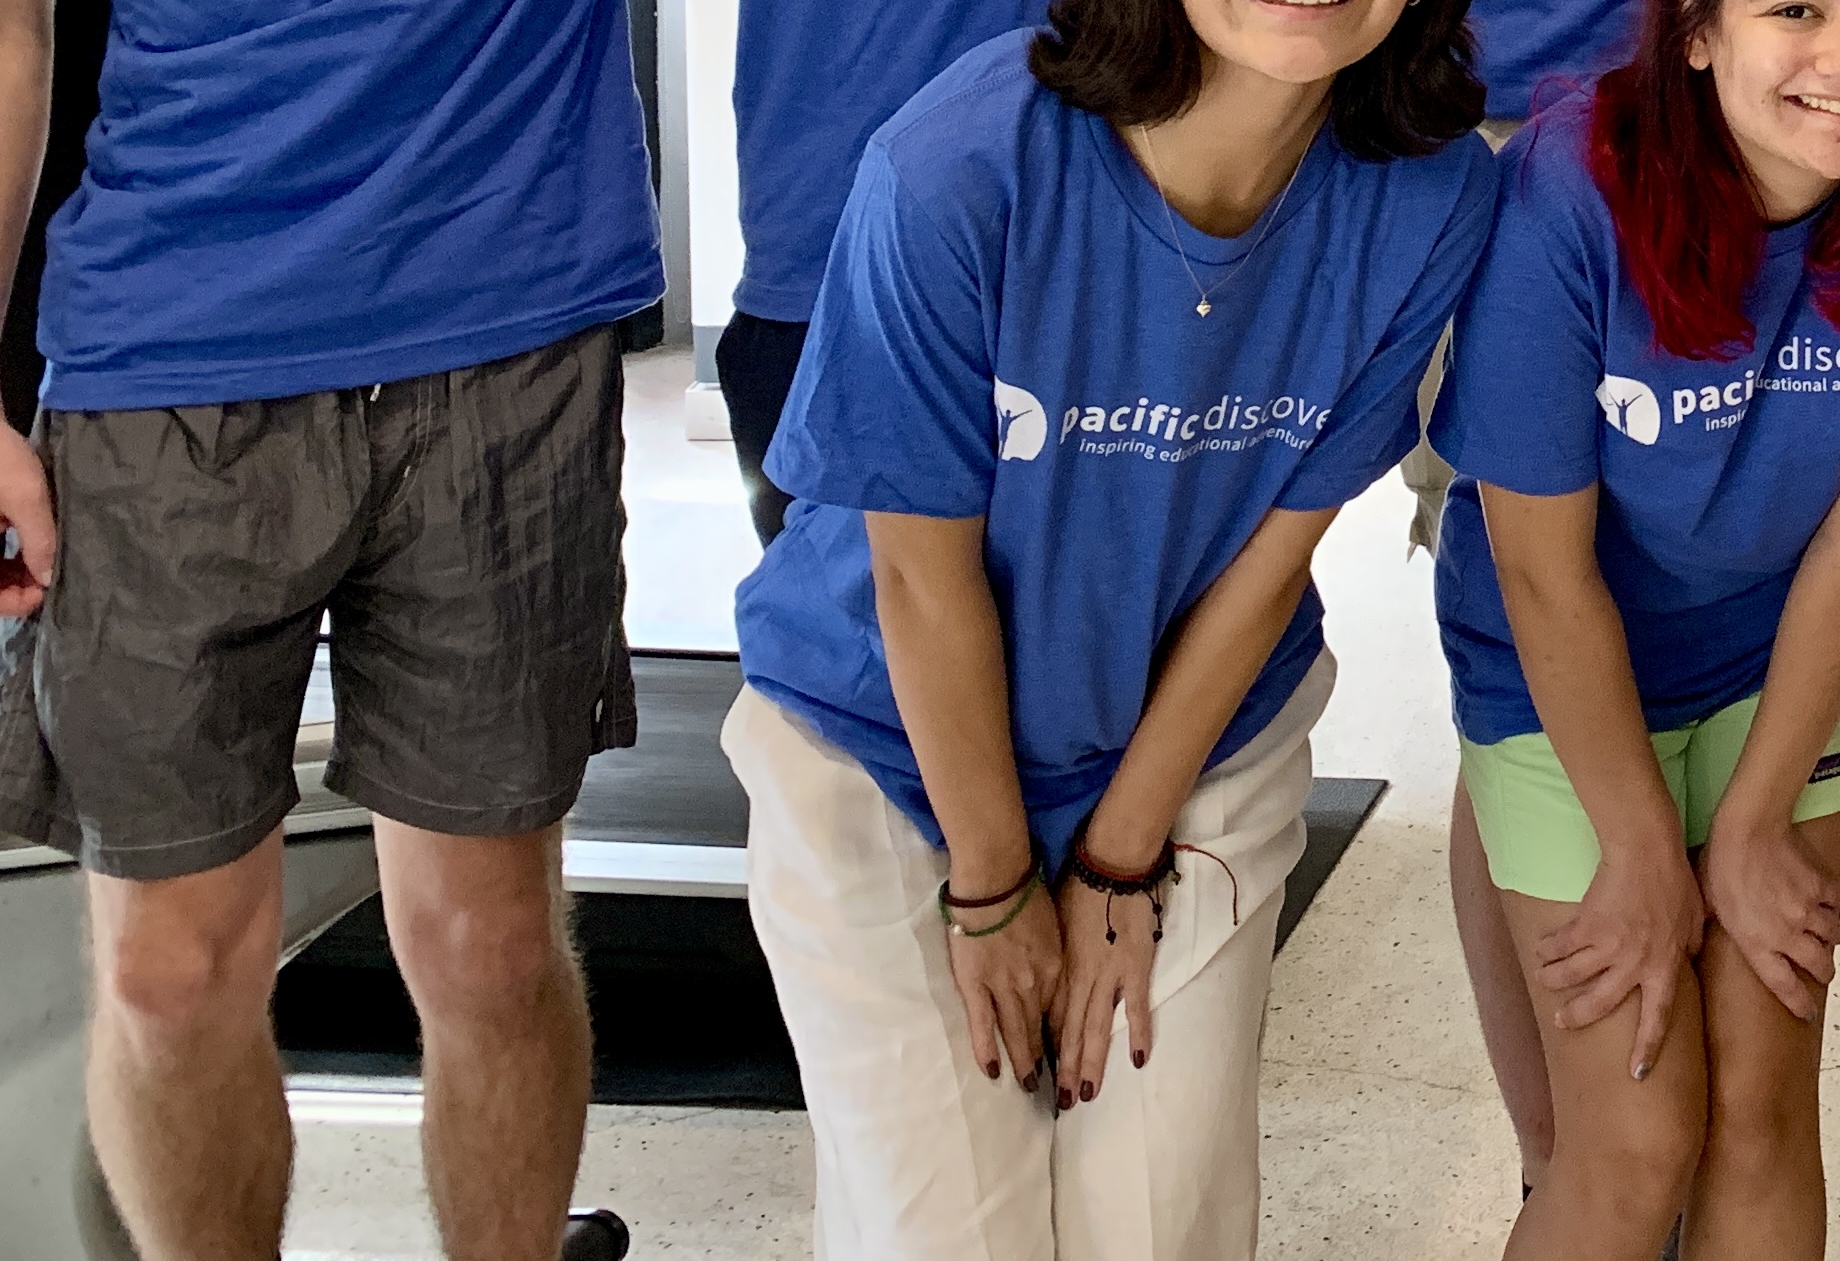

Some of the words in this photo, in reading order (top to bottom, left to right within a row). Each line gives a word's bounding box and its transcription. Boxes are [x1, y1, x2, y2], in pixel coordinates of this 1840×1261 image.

[1061, 397, 1200, 444] pacific
[1203, 394, 1332, 431] disove
[1673, 370, 1754, 424] paci
[1705, 408, 1748, 432] inspir
[1754, 376, 1828, 392] ucational
[1079, 438, 1154, 460] inspiring
